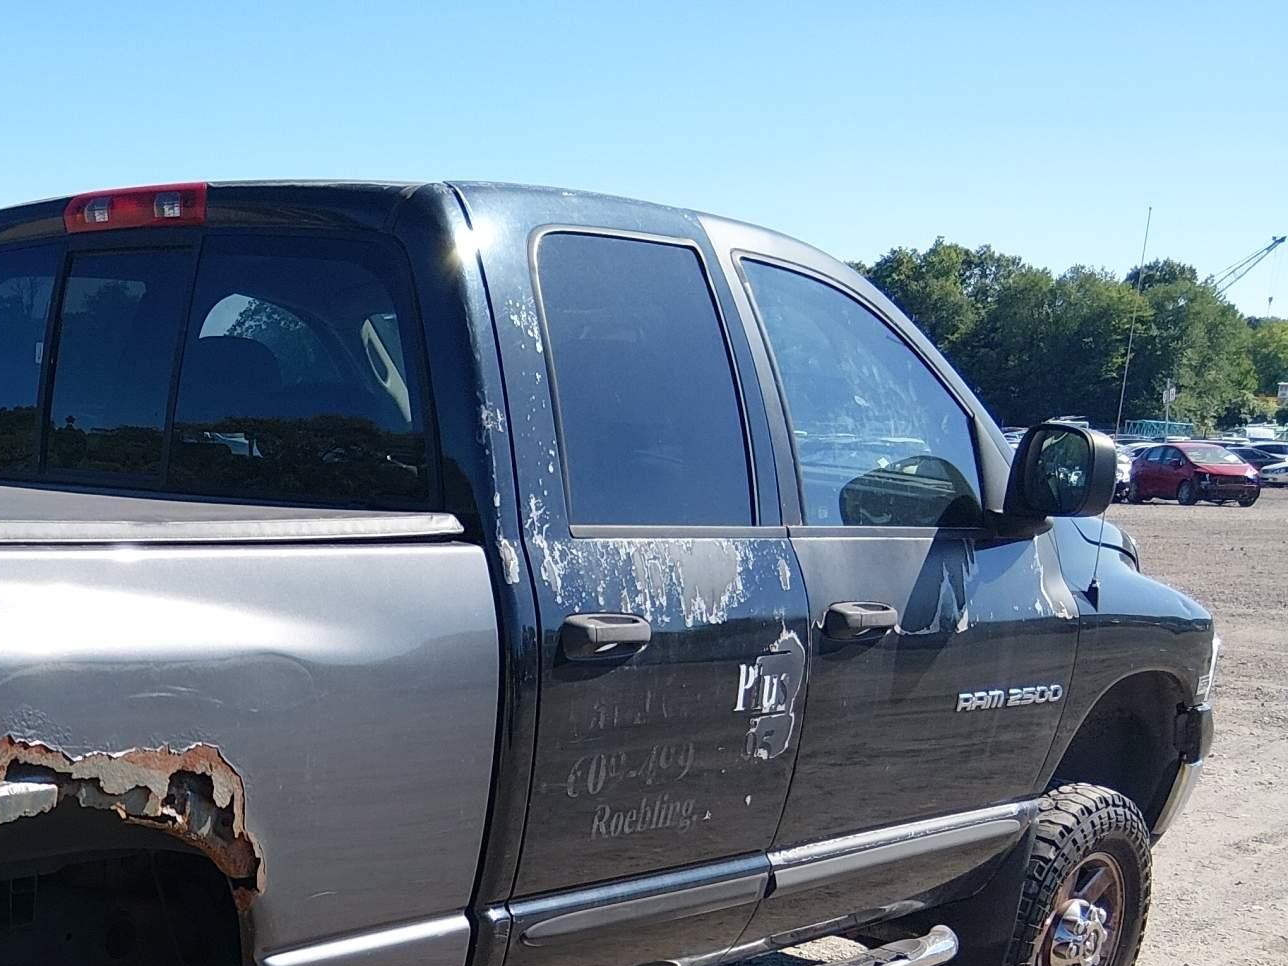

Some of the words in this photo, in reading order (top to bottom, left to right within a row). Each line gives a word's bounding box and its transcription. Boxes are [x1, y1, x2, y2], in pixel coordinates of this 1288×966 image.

[733, 662, 788, 713] Plus
[955, 689, 1005, 713] RAM
[1007, 684, 1063, 707] 2500
